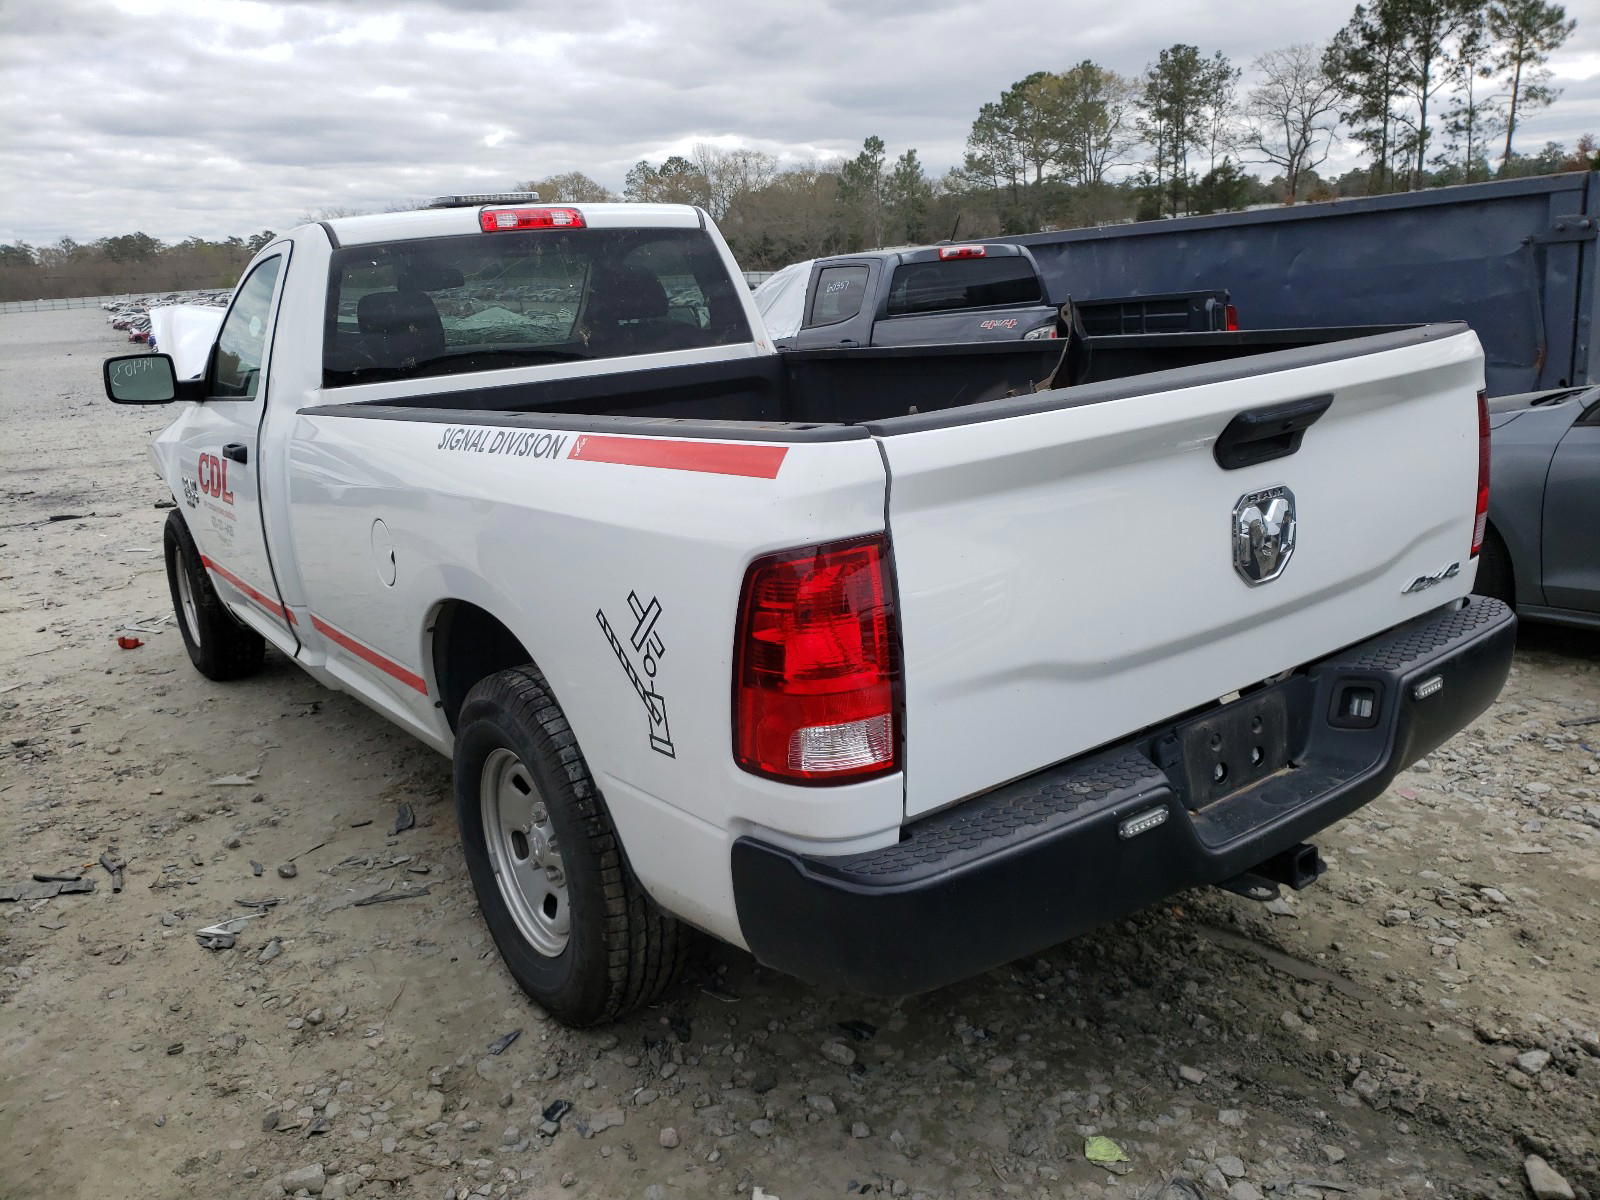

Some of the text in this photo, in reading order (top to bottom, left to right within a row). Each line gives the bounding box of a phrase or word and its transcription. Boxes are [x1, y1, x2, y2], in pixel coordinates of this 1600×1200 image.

[438, 427, 568, 460] SIGNAL DIVISION
[198, 452, 234, 506] CDL
[1248, 487, 1285, 503] RAM
